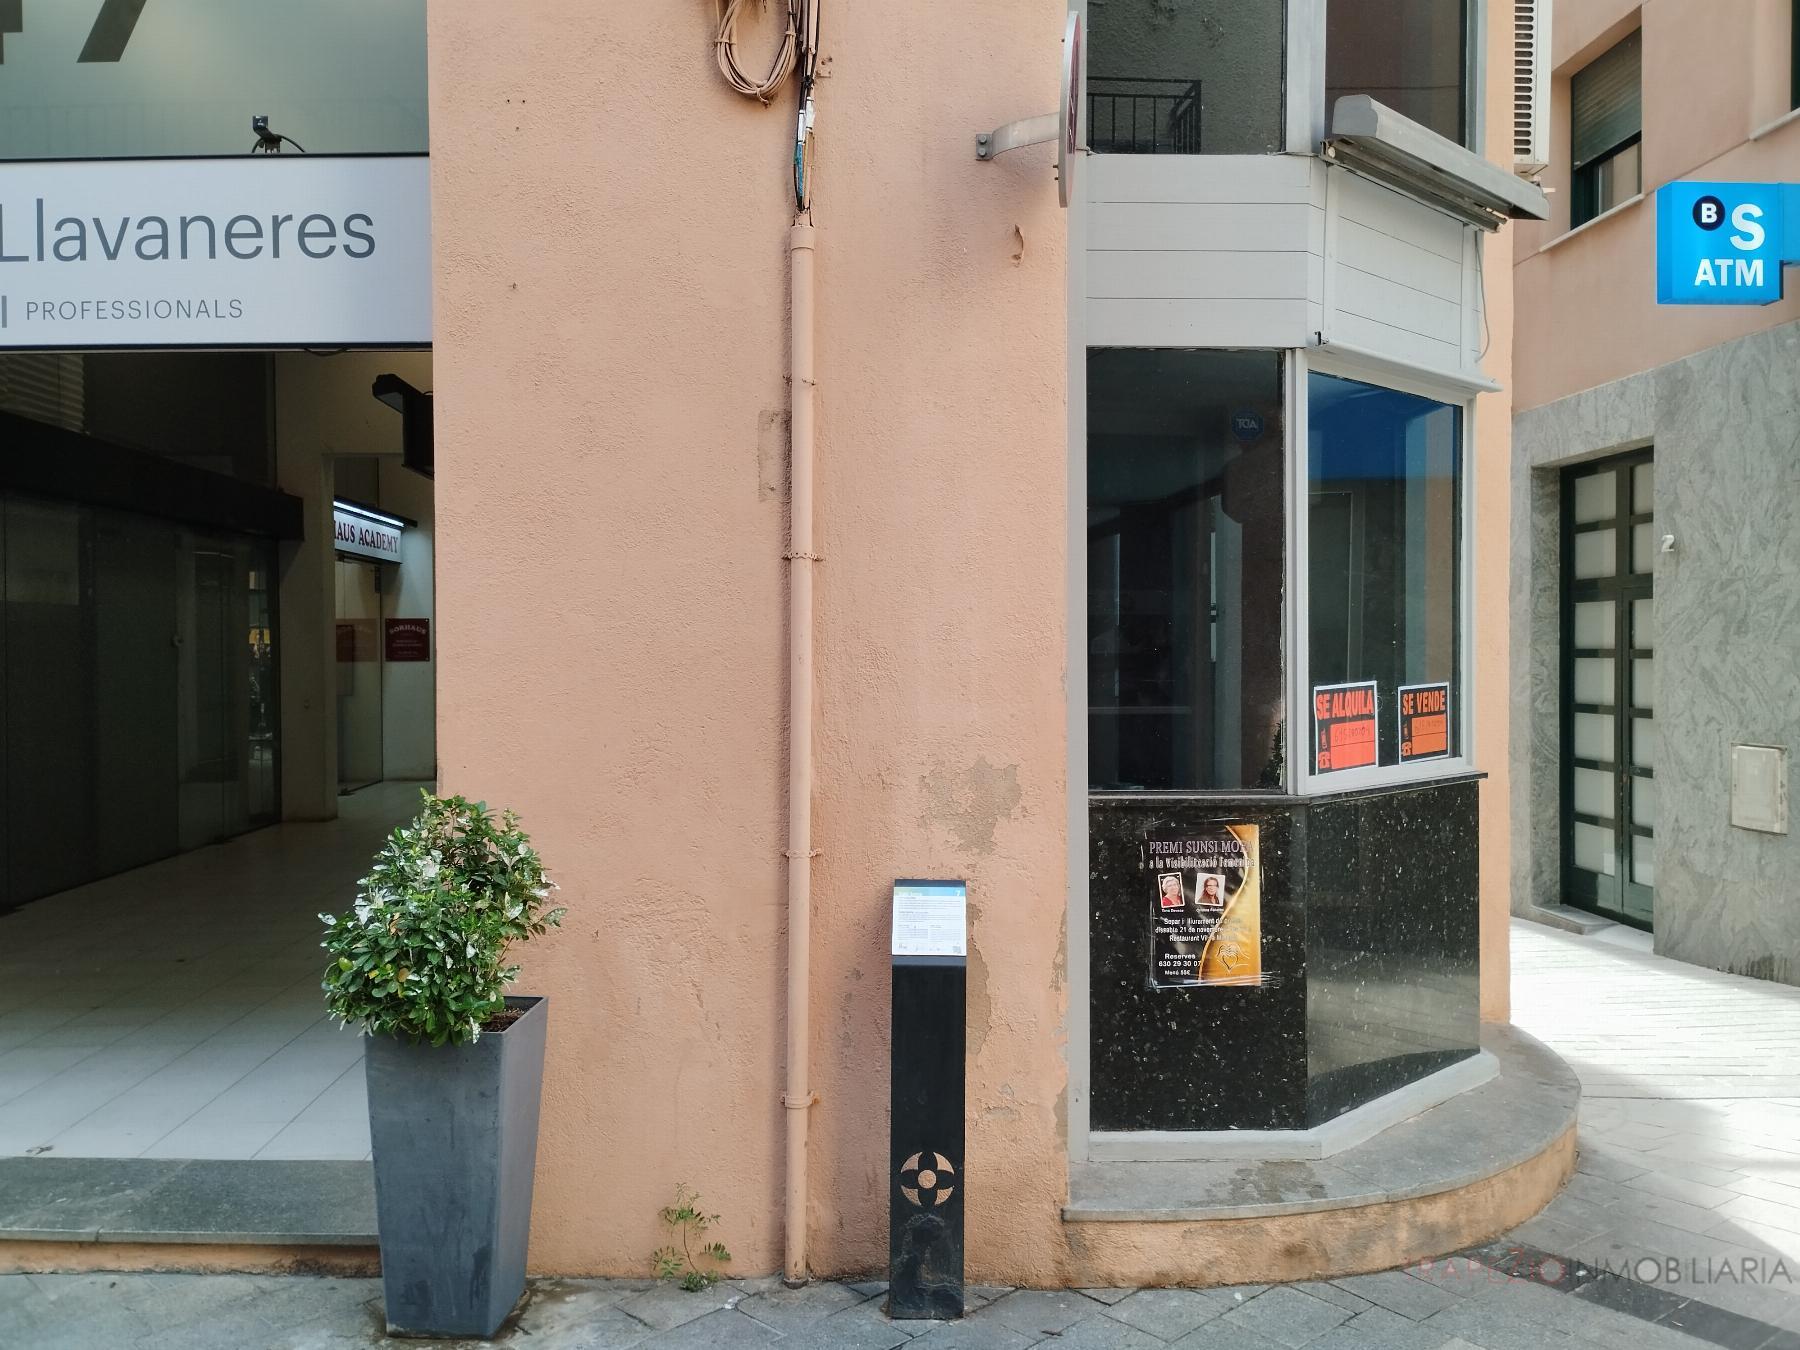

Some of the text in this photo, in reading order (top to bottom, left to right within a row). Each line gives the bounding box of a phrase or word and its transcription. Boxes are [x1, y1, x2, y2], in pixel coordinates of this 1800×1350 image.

[0, 198, 376, 263] Llavaneres
[1694, 258, 1764, 287] ATM
[26, 298, 244, 321] PROFESSIONALS
[358, 527, 398, 553] ACADEMY
[1316, 690, 1374, 720] SE ALQUILA
[1402, 690, 1446, 715] SE VENDE
[1149, 841, 1183, 854] PREMI
[1186, 840, 1218, 853] SUNSI
[1149, 859, 1154, 869] a
[1157, 856, 1164, 869] la
